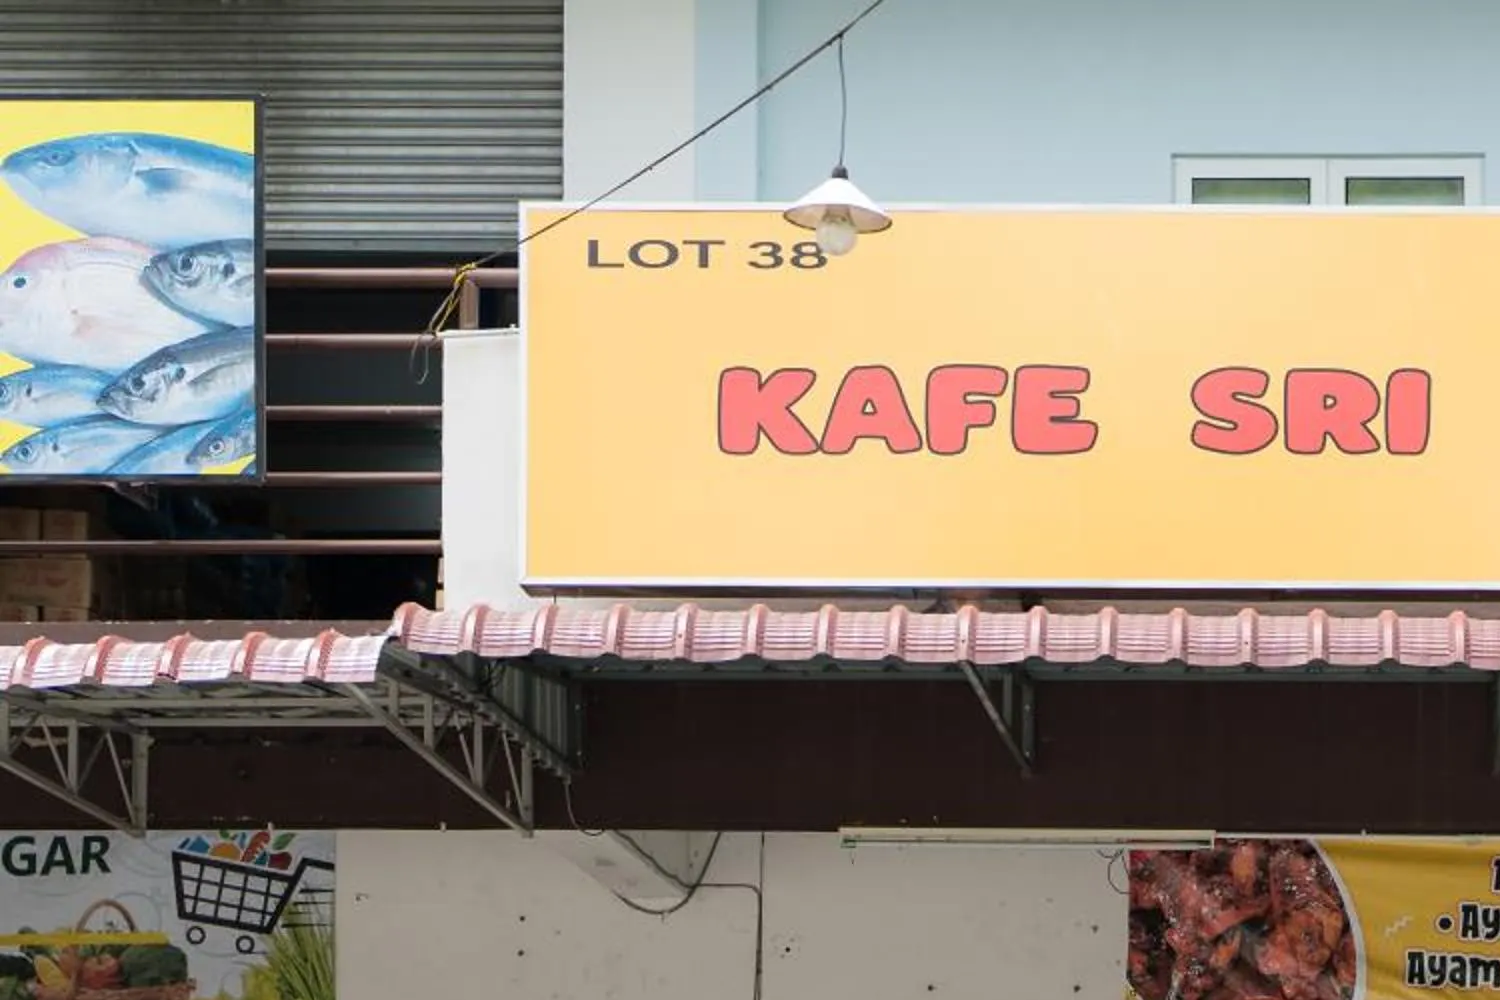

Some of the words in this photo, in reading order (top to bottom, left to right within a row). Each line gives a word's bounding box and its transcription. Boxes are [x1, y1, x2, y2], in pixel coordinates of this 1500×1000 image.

[587, 239, 726, 269] LOT
[747, 241, 829, 270] 38
[715, 363, 1099, 455] KAFE
[1190, 367, 1432, 456] SRI
[2, 834, 112, 877] GAR
